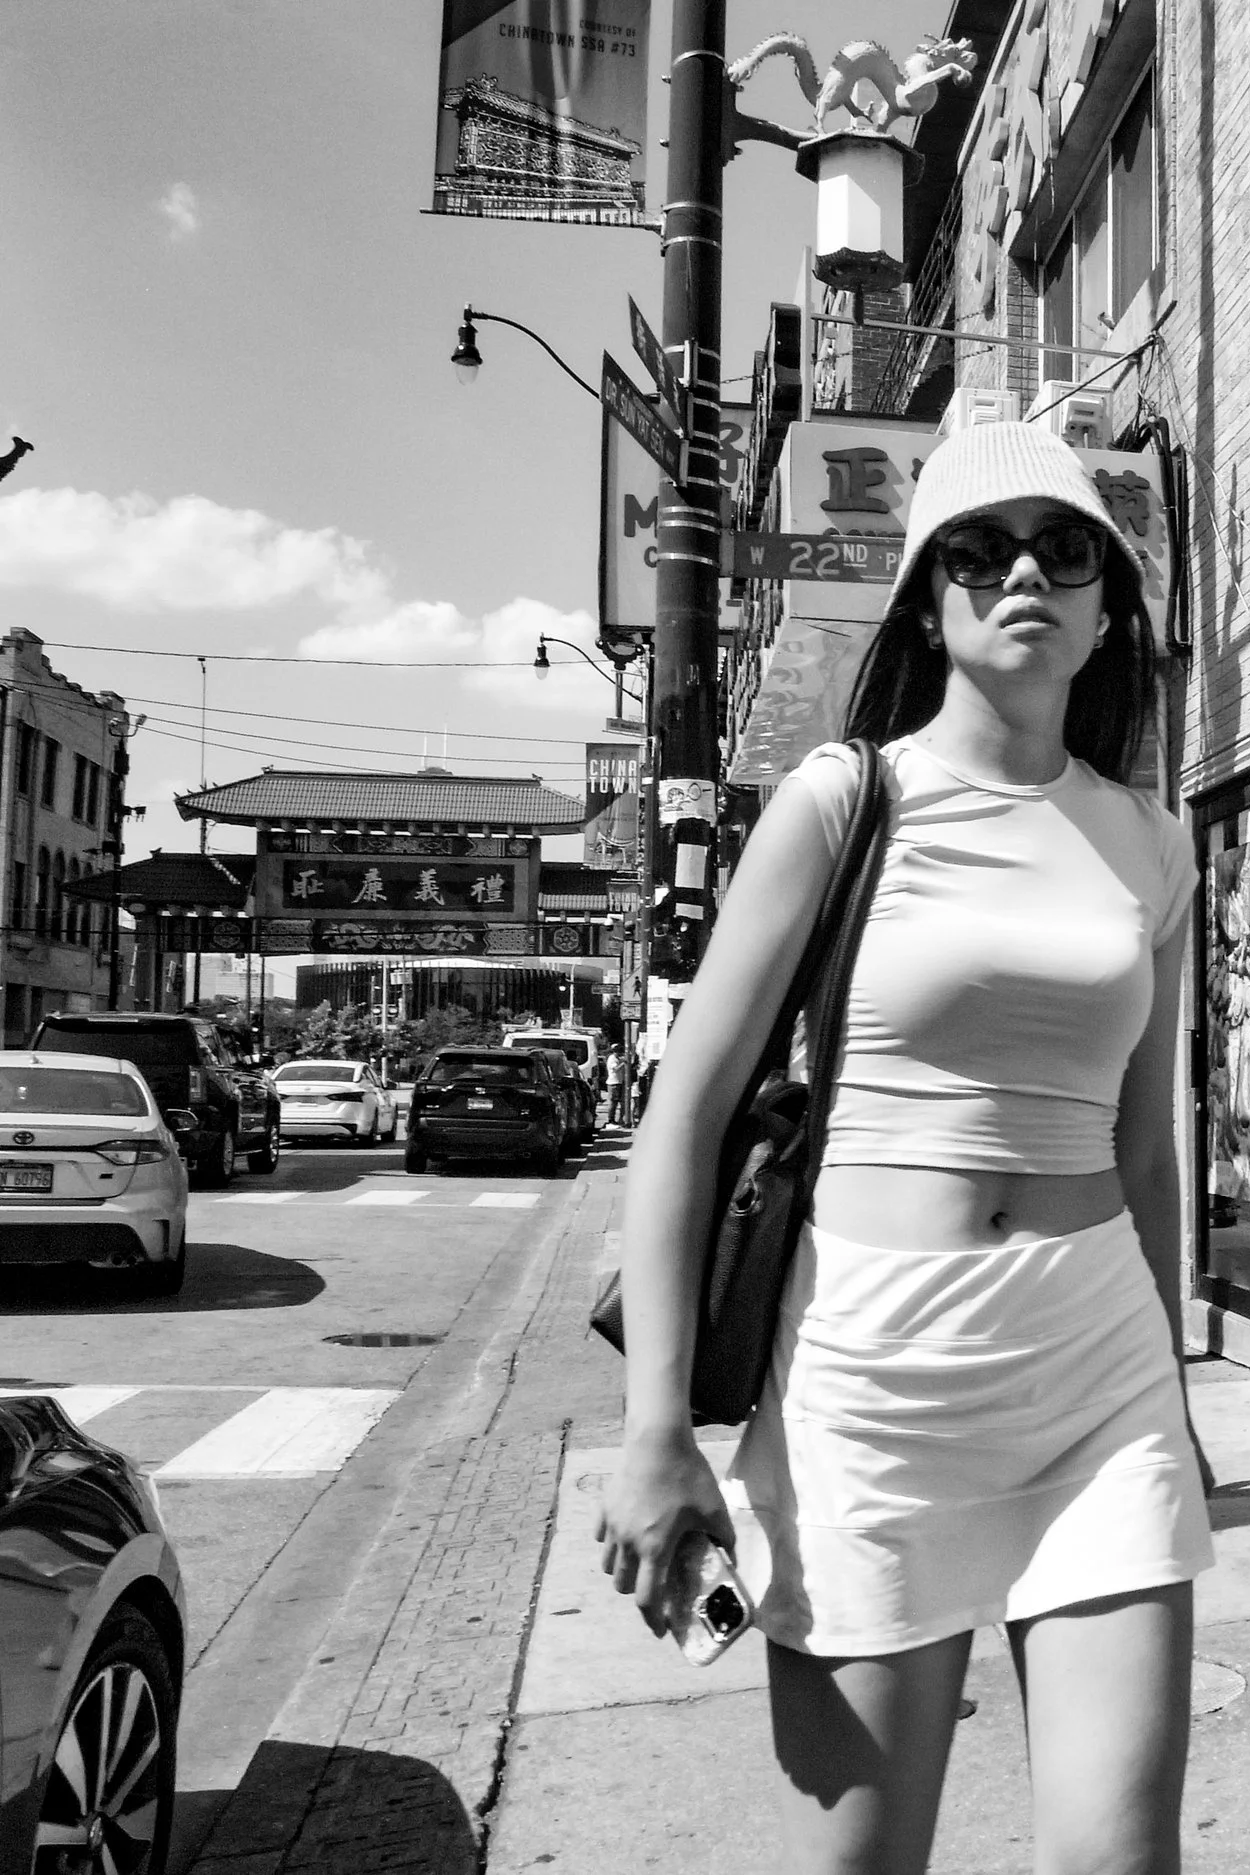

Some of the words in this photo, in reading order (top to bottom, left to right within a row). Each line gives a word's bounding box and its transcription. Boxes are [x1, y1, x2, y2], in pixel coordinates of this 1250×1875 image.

[579, 20, 623, 35] COURTESY
[626, 28, 636, 37] OF
[499, 23, 575, 48] CHINATOWN
[581, 36, 605, 52] SSA
[610, 42, 636, 57] #73
[750, 546, 765, 565] W
[589, 759, 637, 776] CHINA
[589, 776, 637, 794] TOWN
